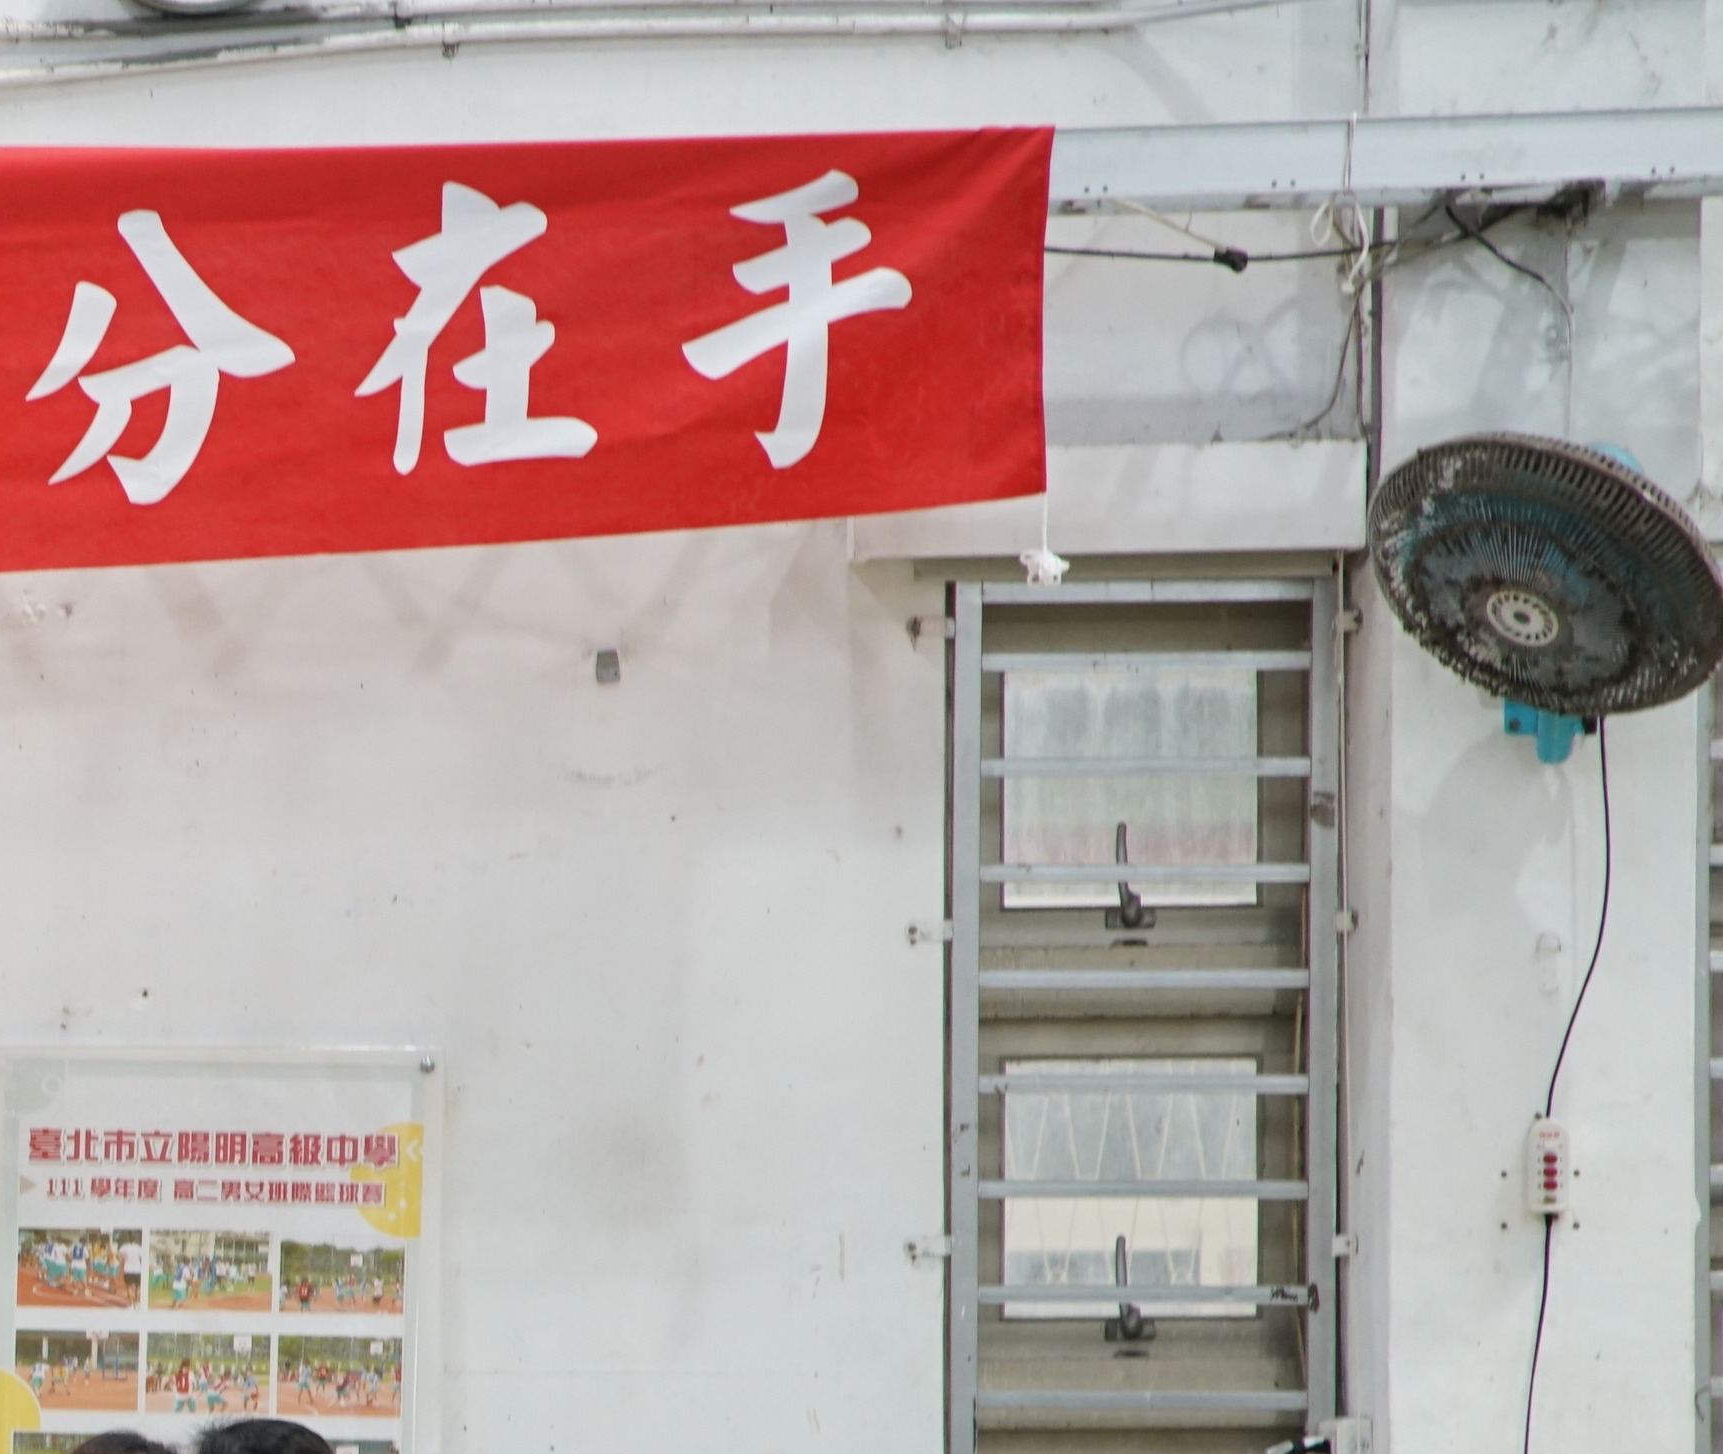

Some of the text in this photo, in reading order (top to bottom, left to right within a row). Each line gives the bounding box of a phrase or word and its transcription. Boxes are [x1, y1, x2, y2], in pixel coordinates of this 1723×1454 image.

[28, 1127, 399, 1168] 臺北市立陽明高級中學
